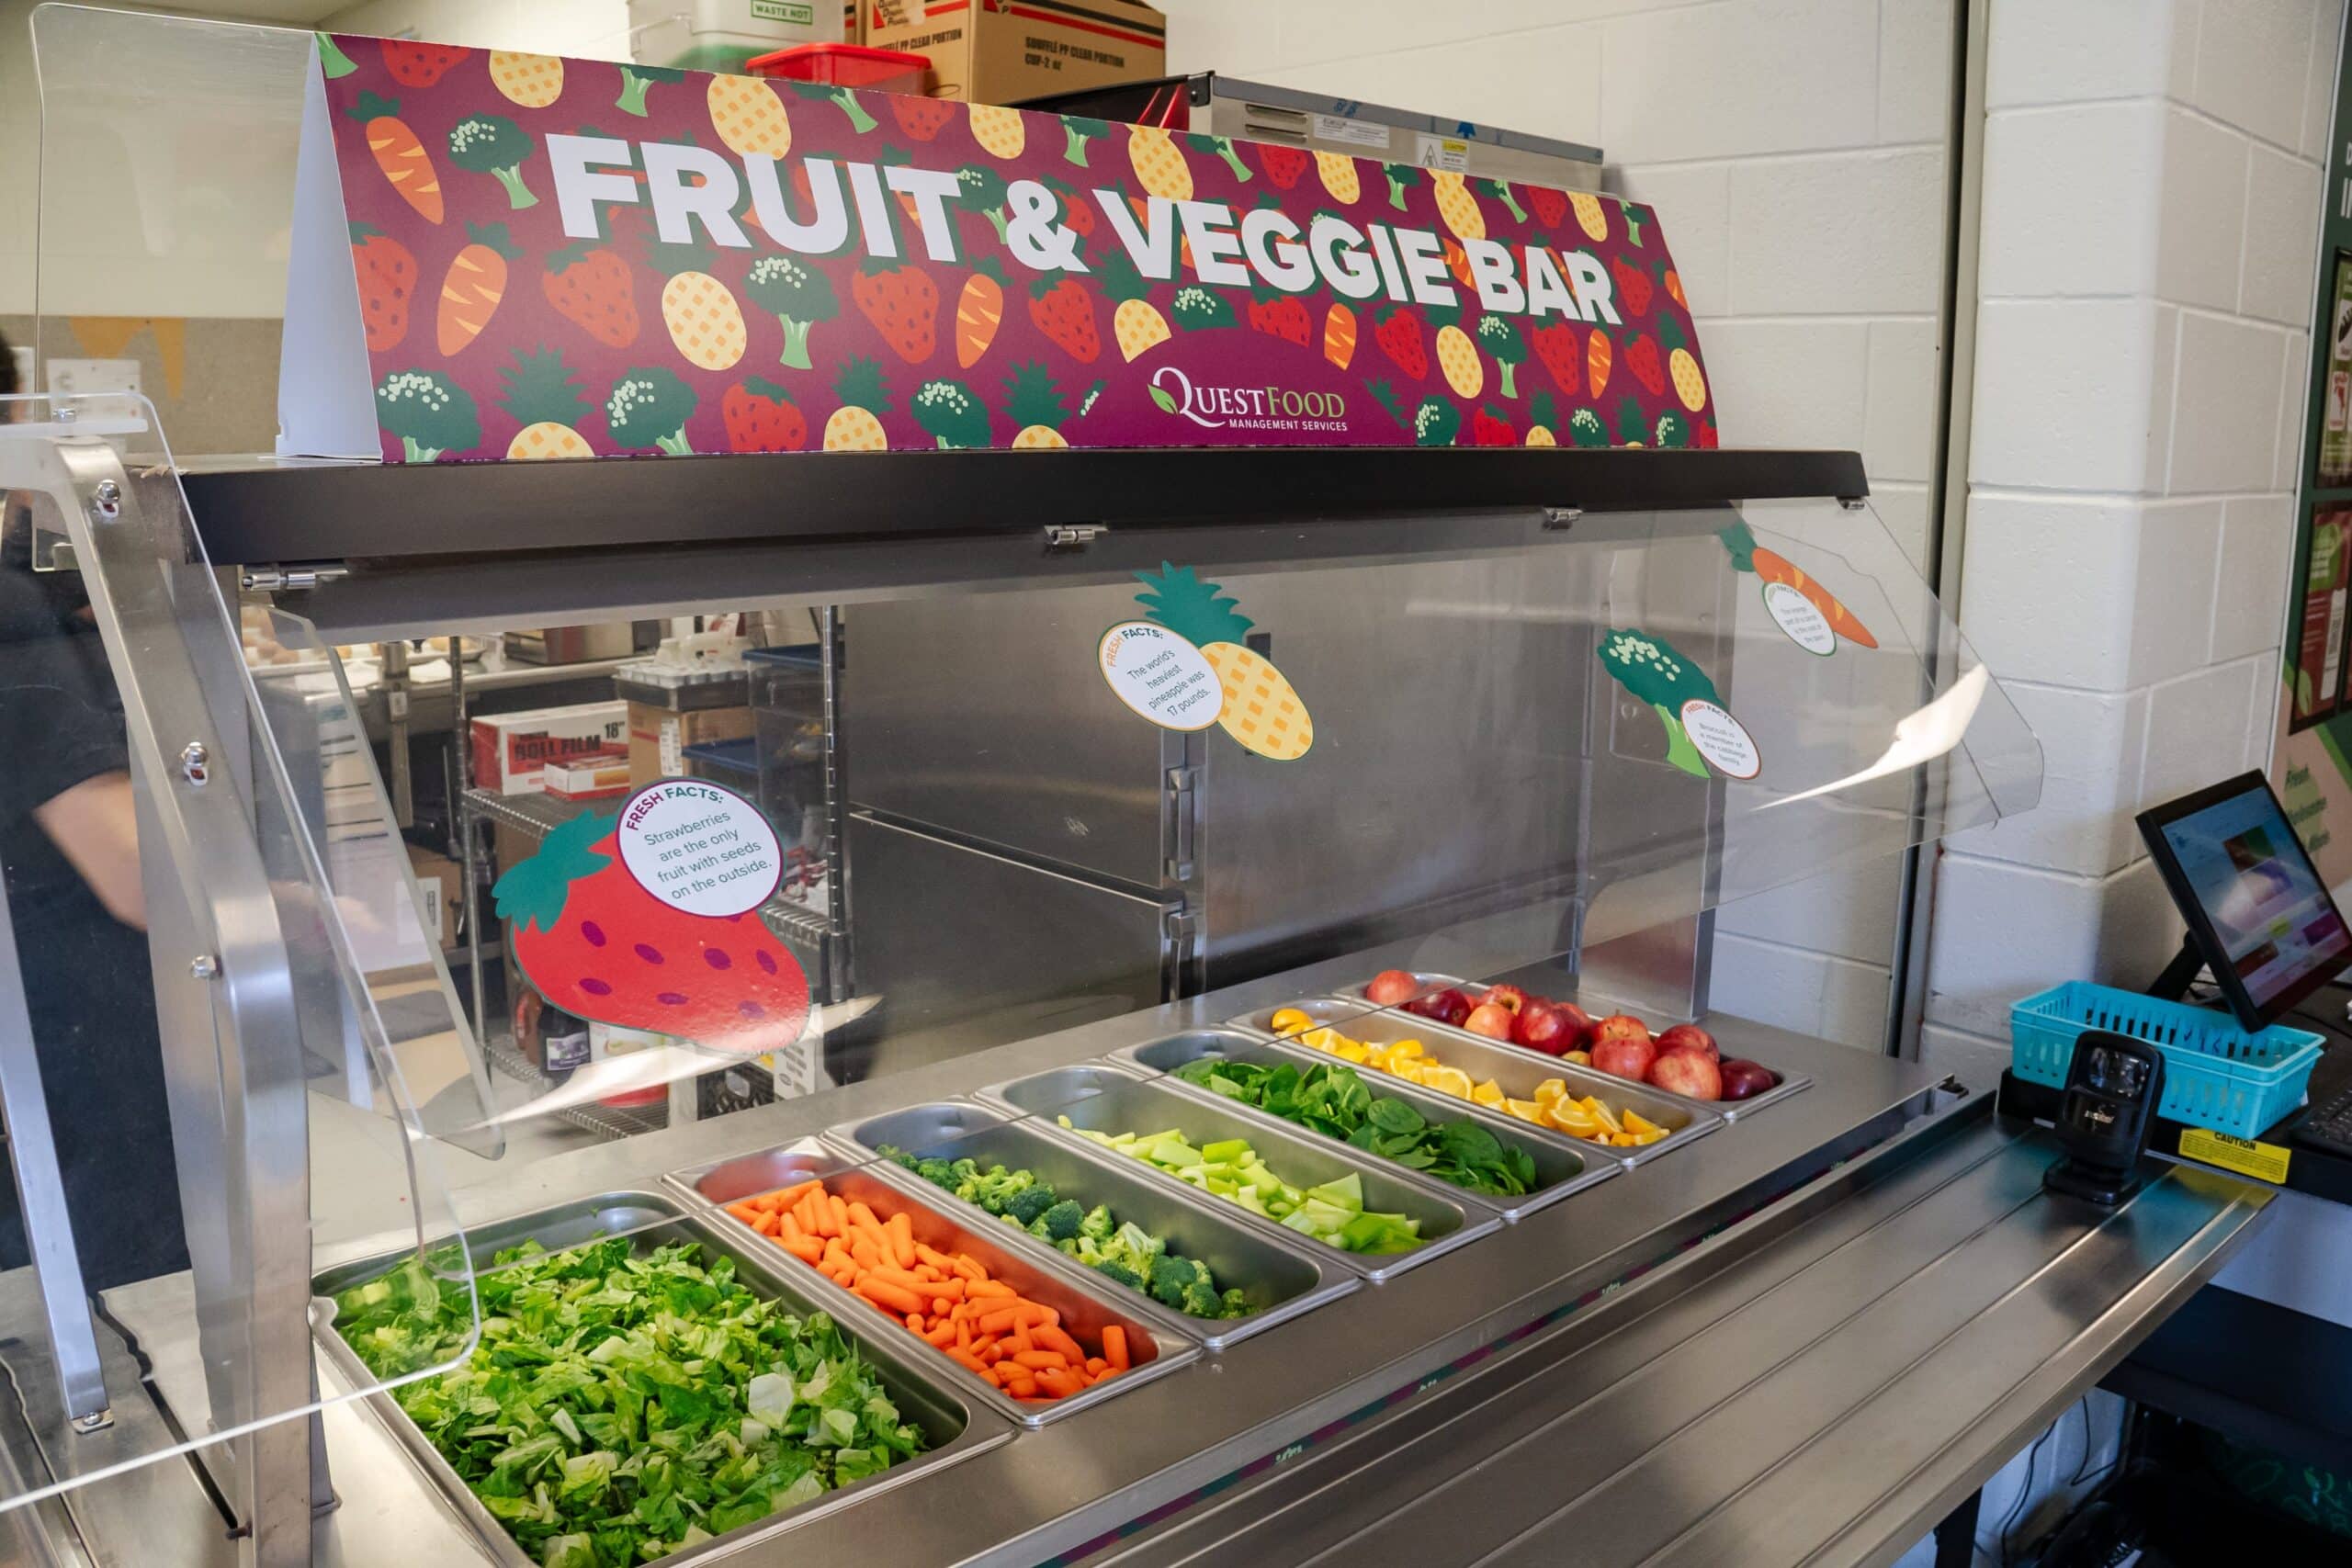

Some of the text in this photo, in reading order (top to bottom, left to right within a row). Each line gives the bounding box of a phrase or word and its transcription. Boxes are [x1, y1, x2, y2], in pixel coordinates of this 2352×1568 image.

[755, 3, 809, 19] WASTE NOT
[910, 35, 931, 50] CLEAR
[932, 28, 963, 45] PORTION
[1070, 46, 1092, 61] CLEAR
[1094, 51, 1125, 68] PORTION
[544, 133, 1623, 324] FRUIT & VEGGIE BAR
[1228, 418, 1348, 431] MANAGEMENT SERVICES
[1106, 627, 1164, 667] FRESH FACTS:
[1127, 649, 1176, 681] The world's
[1146, 664, 1183, 690] heaviest
[1148, 671, 1205, 711] pineapple was
[1167, 688, 1211, 716] 17 pounds.
[514, 741, 556, 761] ROLL
[560, 735, 601, 755] FILM
[626, 786, 724, 831] FRESH FACTS:
[644, 811, 731, 846] Strawberries
[658, 840, 762, 883] fruit with seeds
[659, 829, 739, 862] are the only
[671, 859, 773, 899] on the outside.
[2213, 1131, 2257, 1151] CAUTION
